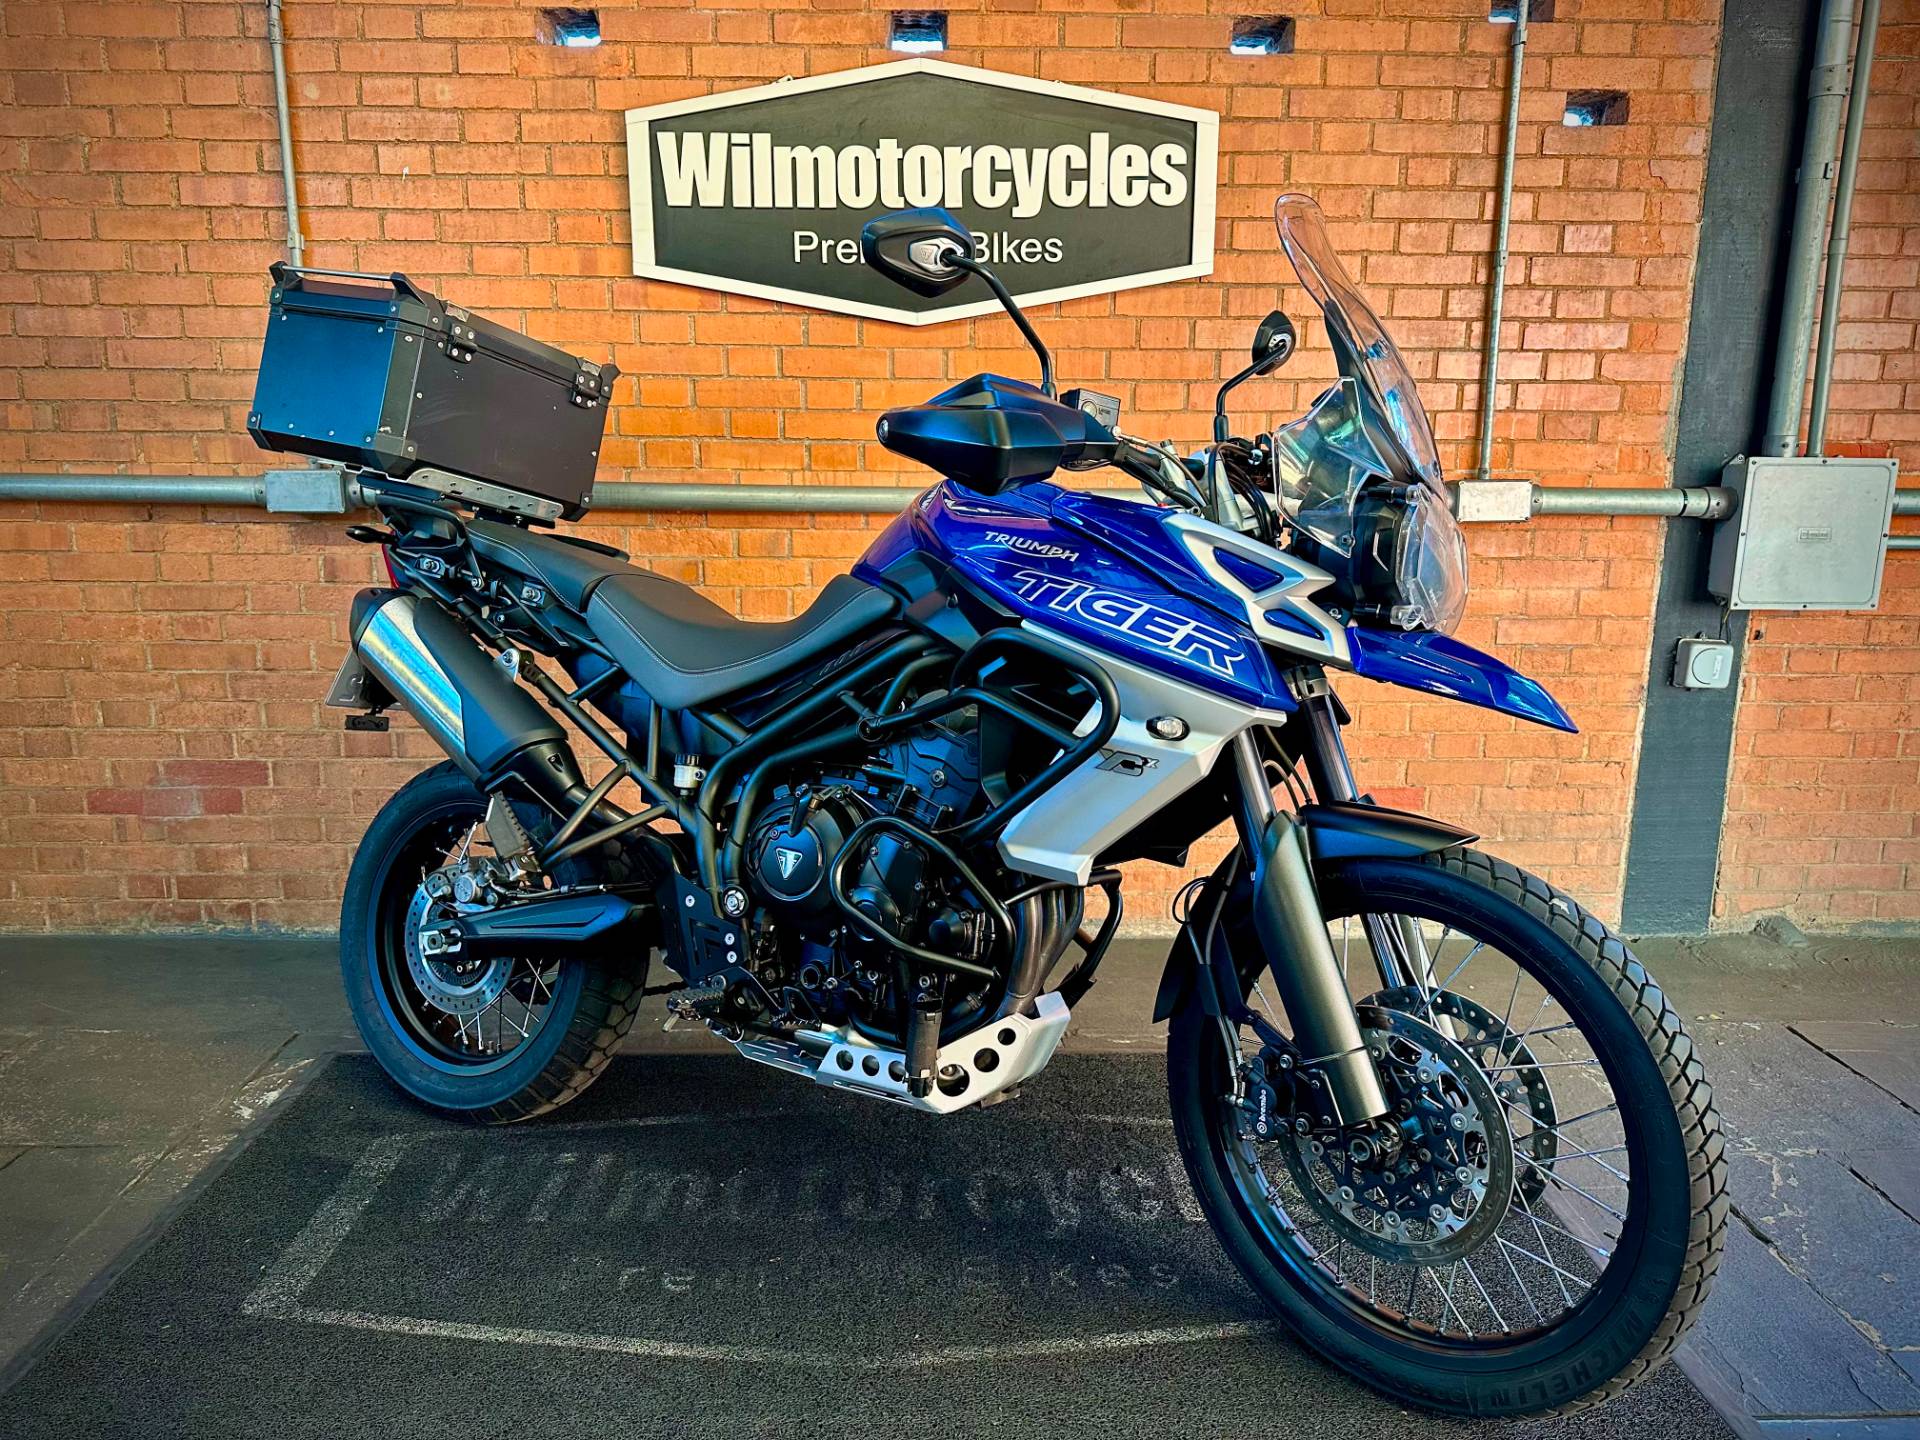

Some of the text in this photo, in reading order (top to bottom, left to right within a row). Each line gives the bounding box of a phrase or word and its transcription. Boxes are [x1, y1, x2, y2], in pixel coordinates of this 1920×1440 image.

[656, 130, 1188, 218] Wilmotorcycles
[985, 531, 1080, 562] TRIUMPH
[1013, 570, 1245, 677] TIGER
[1489, 1310, 1643, 1407] MICHELIN
